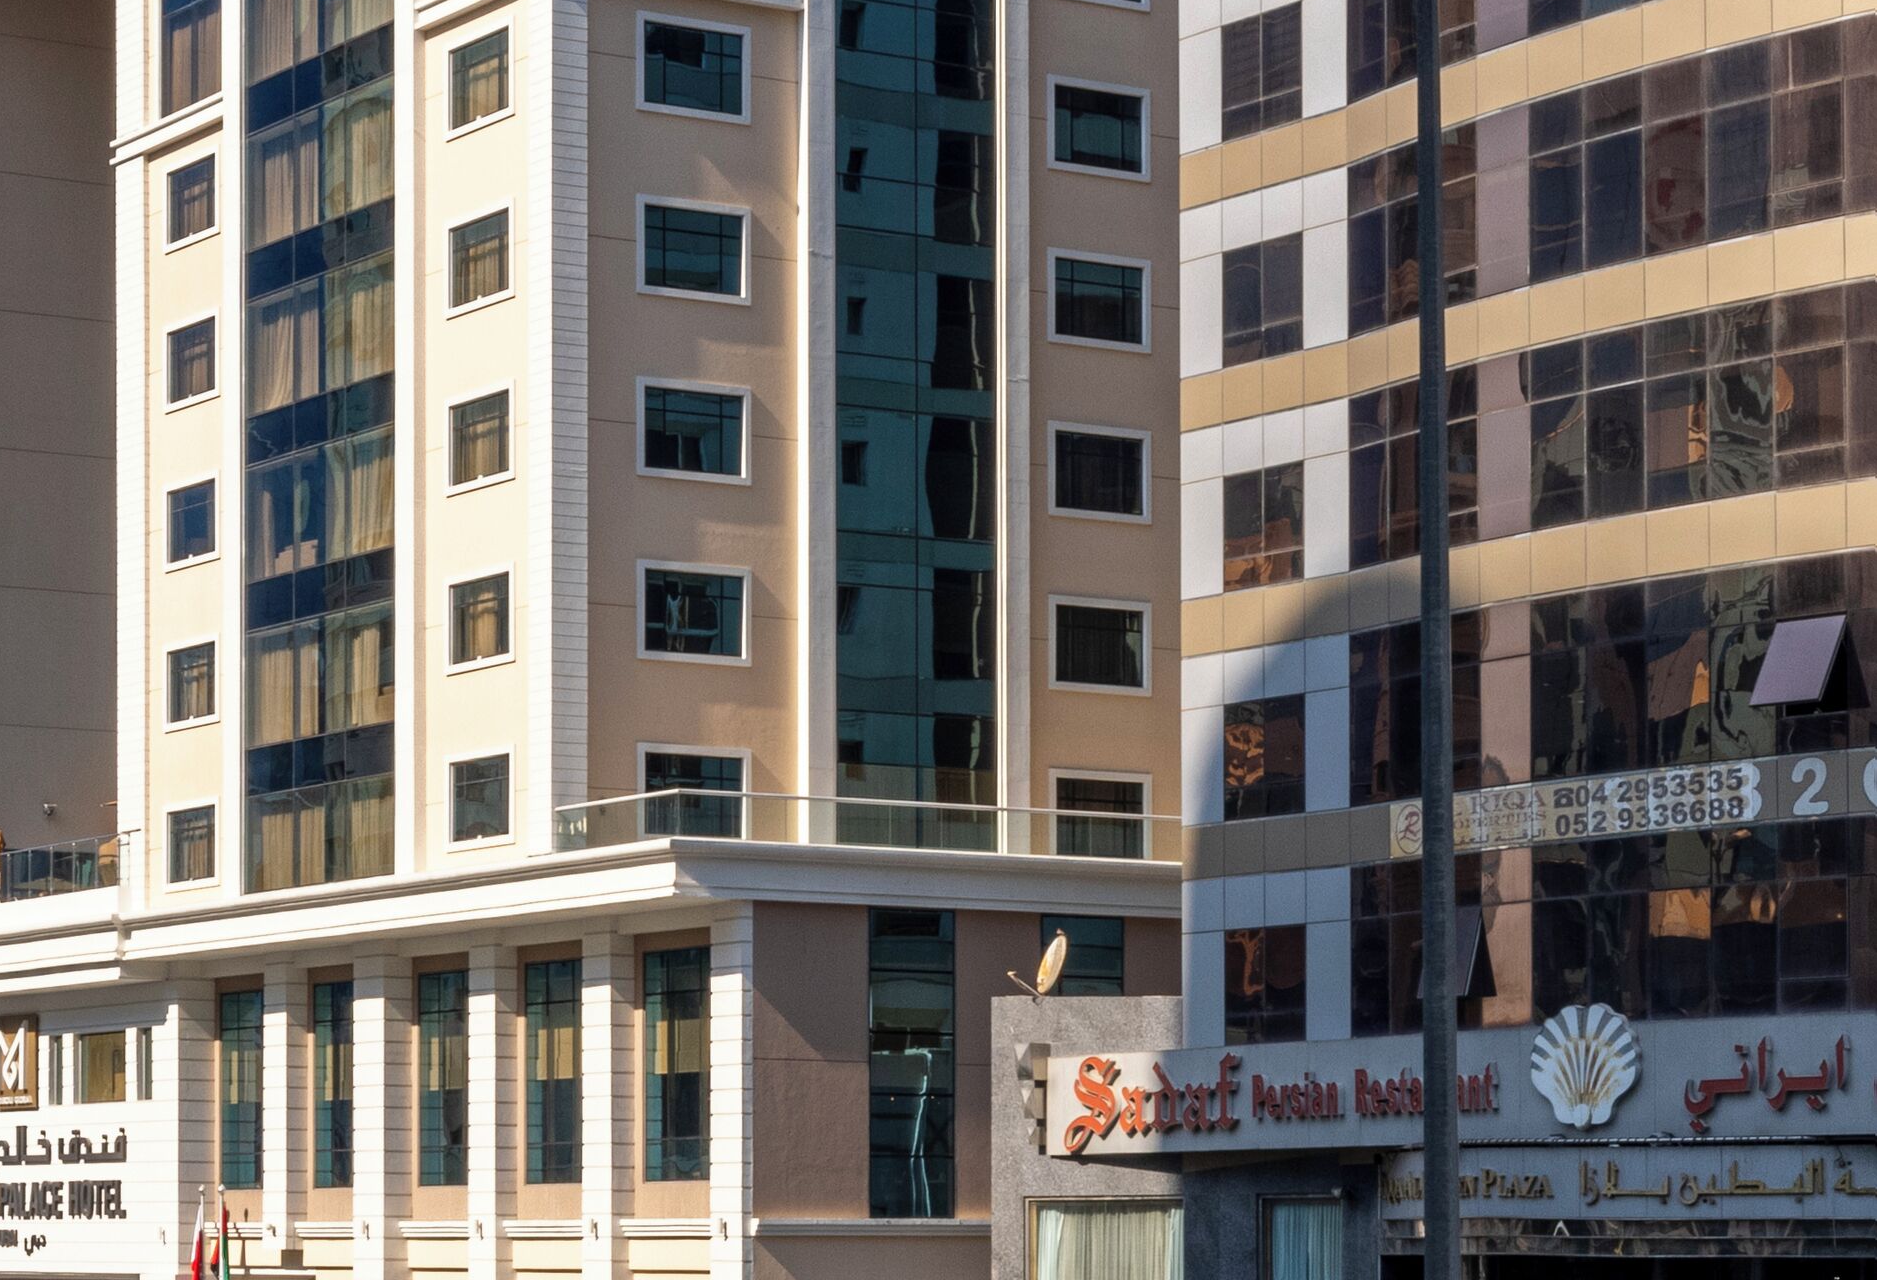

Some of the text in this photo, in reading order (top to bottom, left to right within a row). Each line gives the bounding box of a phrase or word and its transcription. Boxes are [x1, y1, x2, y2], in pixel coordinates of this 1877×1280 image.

[1470, 790, 1547, 815] RIQA
[1574, 767, 1744, 808] 04 2953535
[1454, 810, 1547, 829] OPERTIES
[1555, 795, 1745, 837] 052 9336688
[1063, 1052, 1499, 1153] Sadaf Persian Restaant
[58, 1127, 127, 1165] فندق
[68, 1179, 127, 1220] HOTEL
[1481, 1168, 1554, 1200] PLAZA
